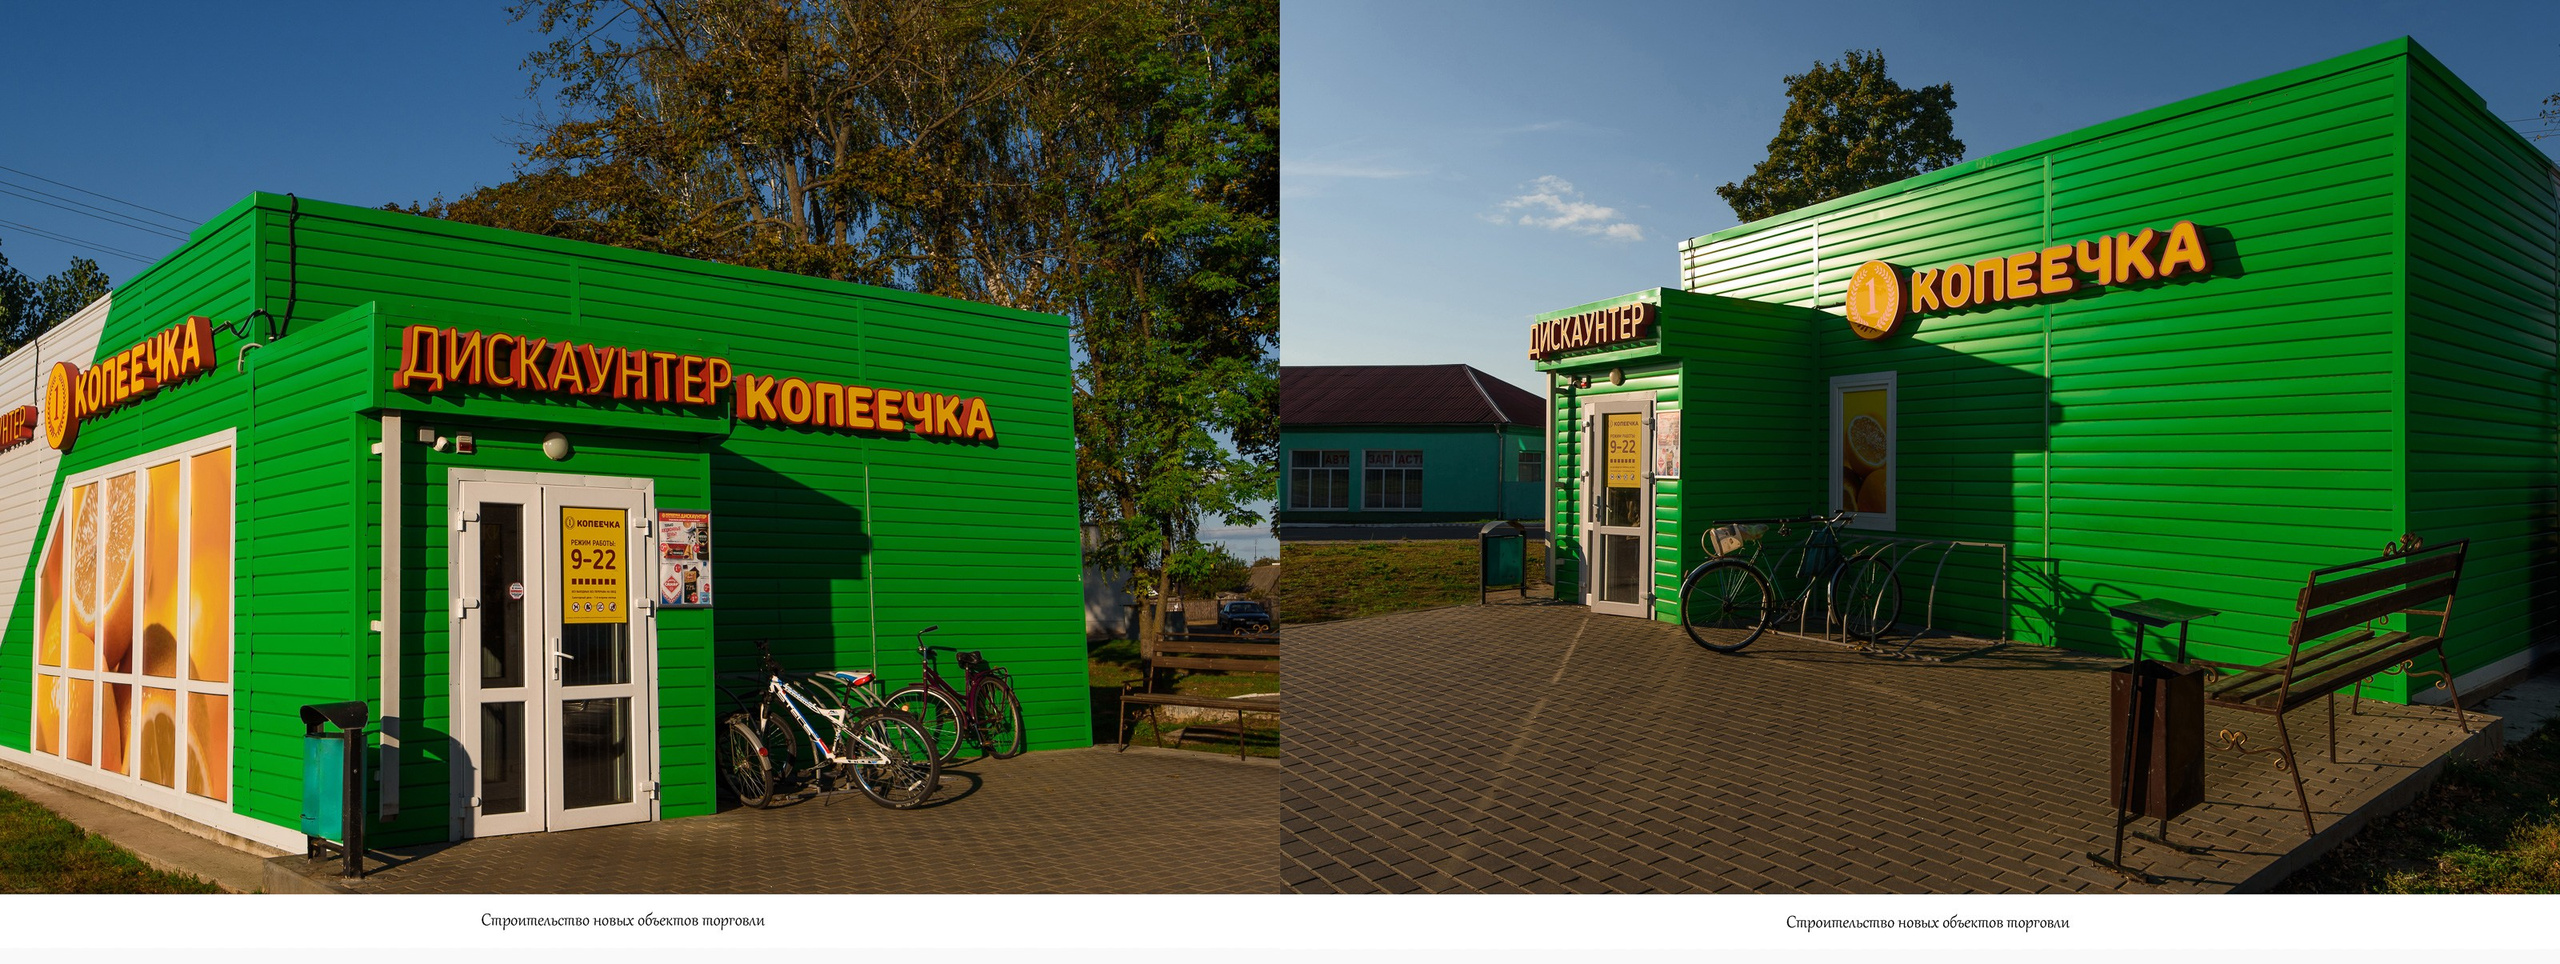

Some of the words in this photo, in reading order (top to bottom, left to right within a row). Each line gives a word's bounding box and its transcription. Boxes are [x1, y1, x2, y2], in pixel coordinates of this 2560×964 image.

[1911, 220, 2206, 313] КОПЕЕЧКА
[1528, 302, 1644, 360] ДИСКАУНТЕР
[75, 316, 201, 418] КОПЕЕЧКА
[402, 325, 732, 406] ДИСКАУНТЕР
[743, 373, 995, 440] КОПЕЕЧКА
[1610, 440, 1636, 454] 9-22
[576, 519, 621, 529] КОПЕЕЧКА
[571, 548, 617, 570] 9-22
